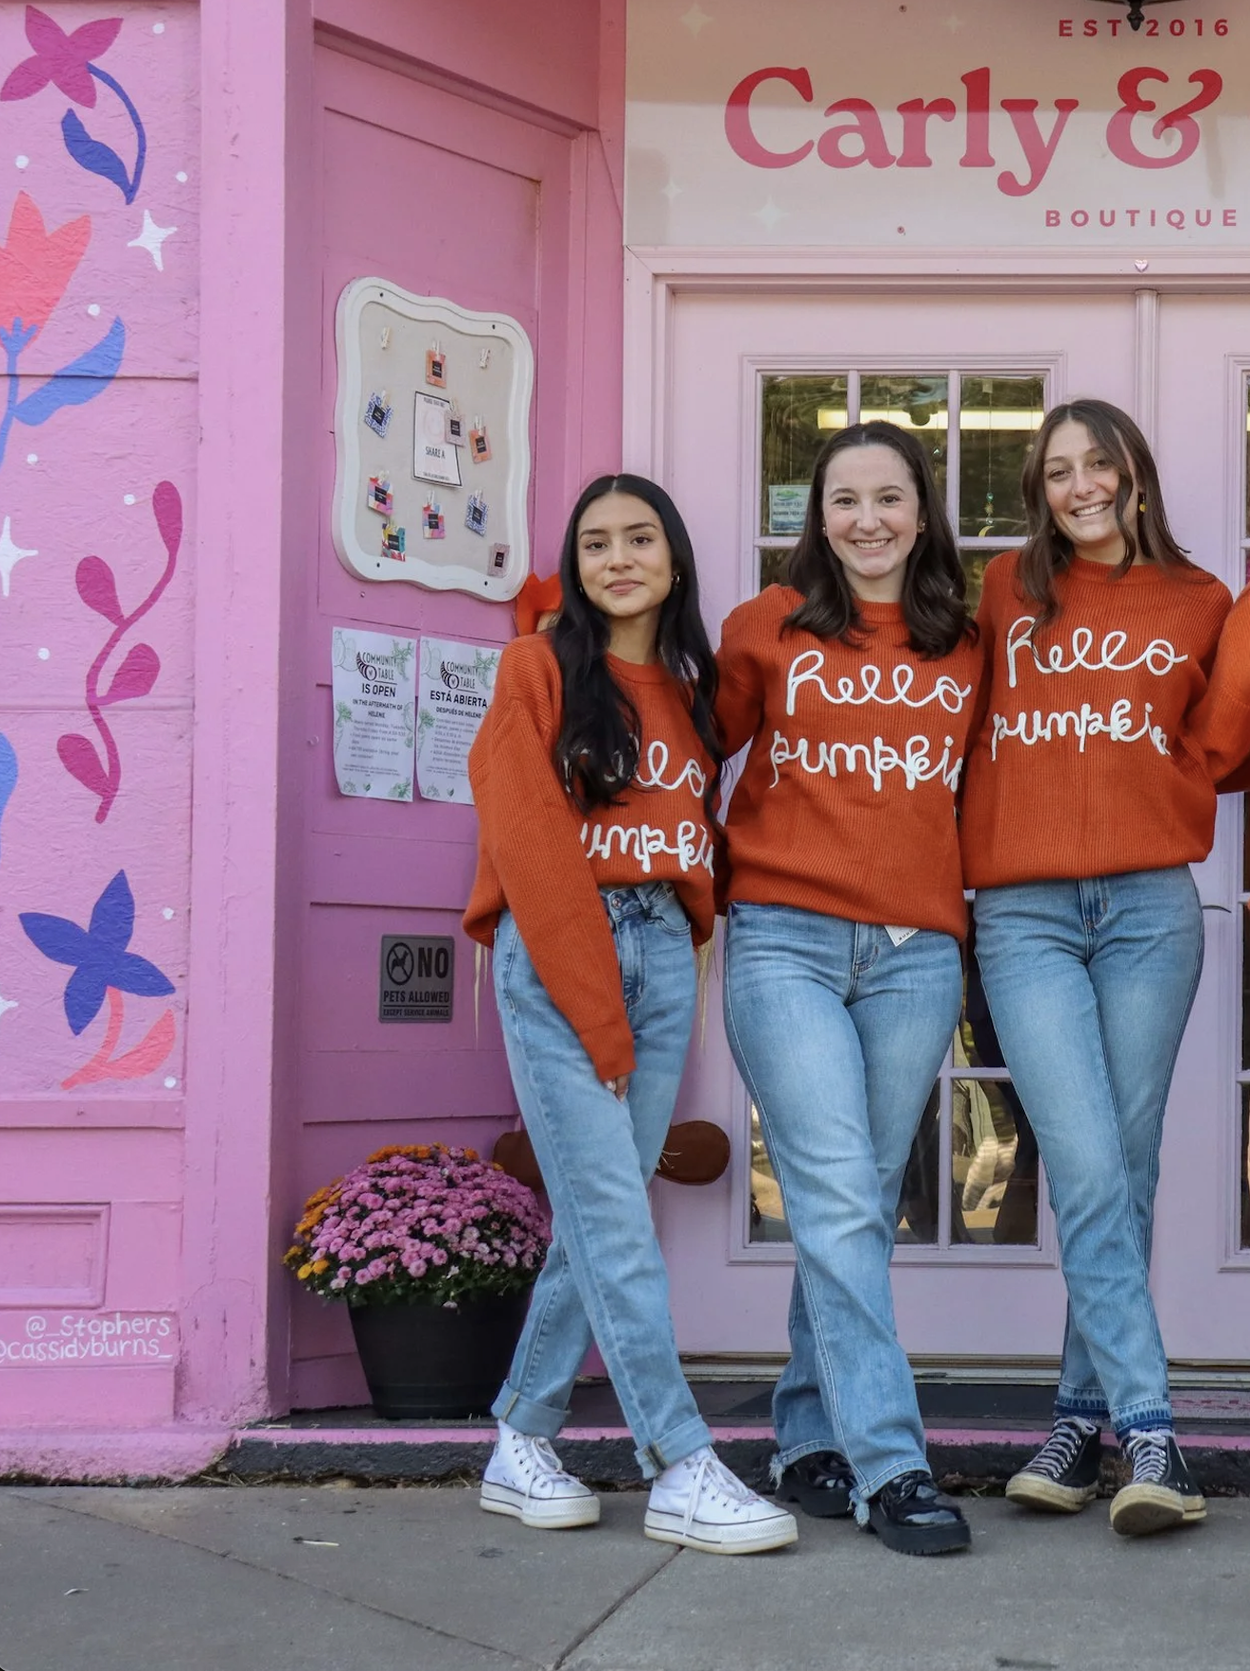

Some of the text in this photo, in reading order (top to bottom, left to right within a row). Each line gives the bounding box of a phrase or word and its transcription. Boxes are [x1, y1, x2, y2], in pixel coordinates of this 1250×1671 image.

[1058, 18, 1229, 37] EST 2016
[725, 66, 1078, 196] Carly
[1106, 66, 1223, 168] &
[1045, 209, 1239, 228] BOUTIQUE
[425, 446, 446, 459] SHARE A
[362, 651, 398, 668] COMMUNITY
[1006, 615, 1189, 688] hello
[378, 667, 394, 681] TABLE
[460, 676, 476, 689] TABLE
[786, 650, 972, 716] hello
[362, 682, 396, 698] IS OPEN
[368, 700, 397, 710] AFTERMATH
[430, 690, 488, 709] ESTÁ ABIERTA
[417, 947, 449, 979] NO
[383, 990, 450, 1003] PETS ALLOWED
